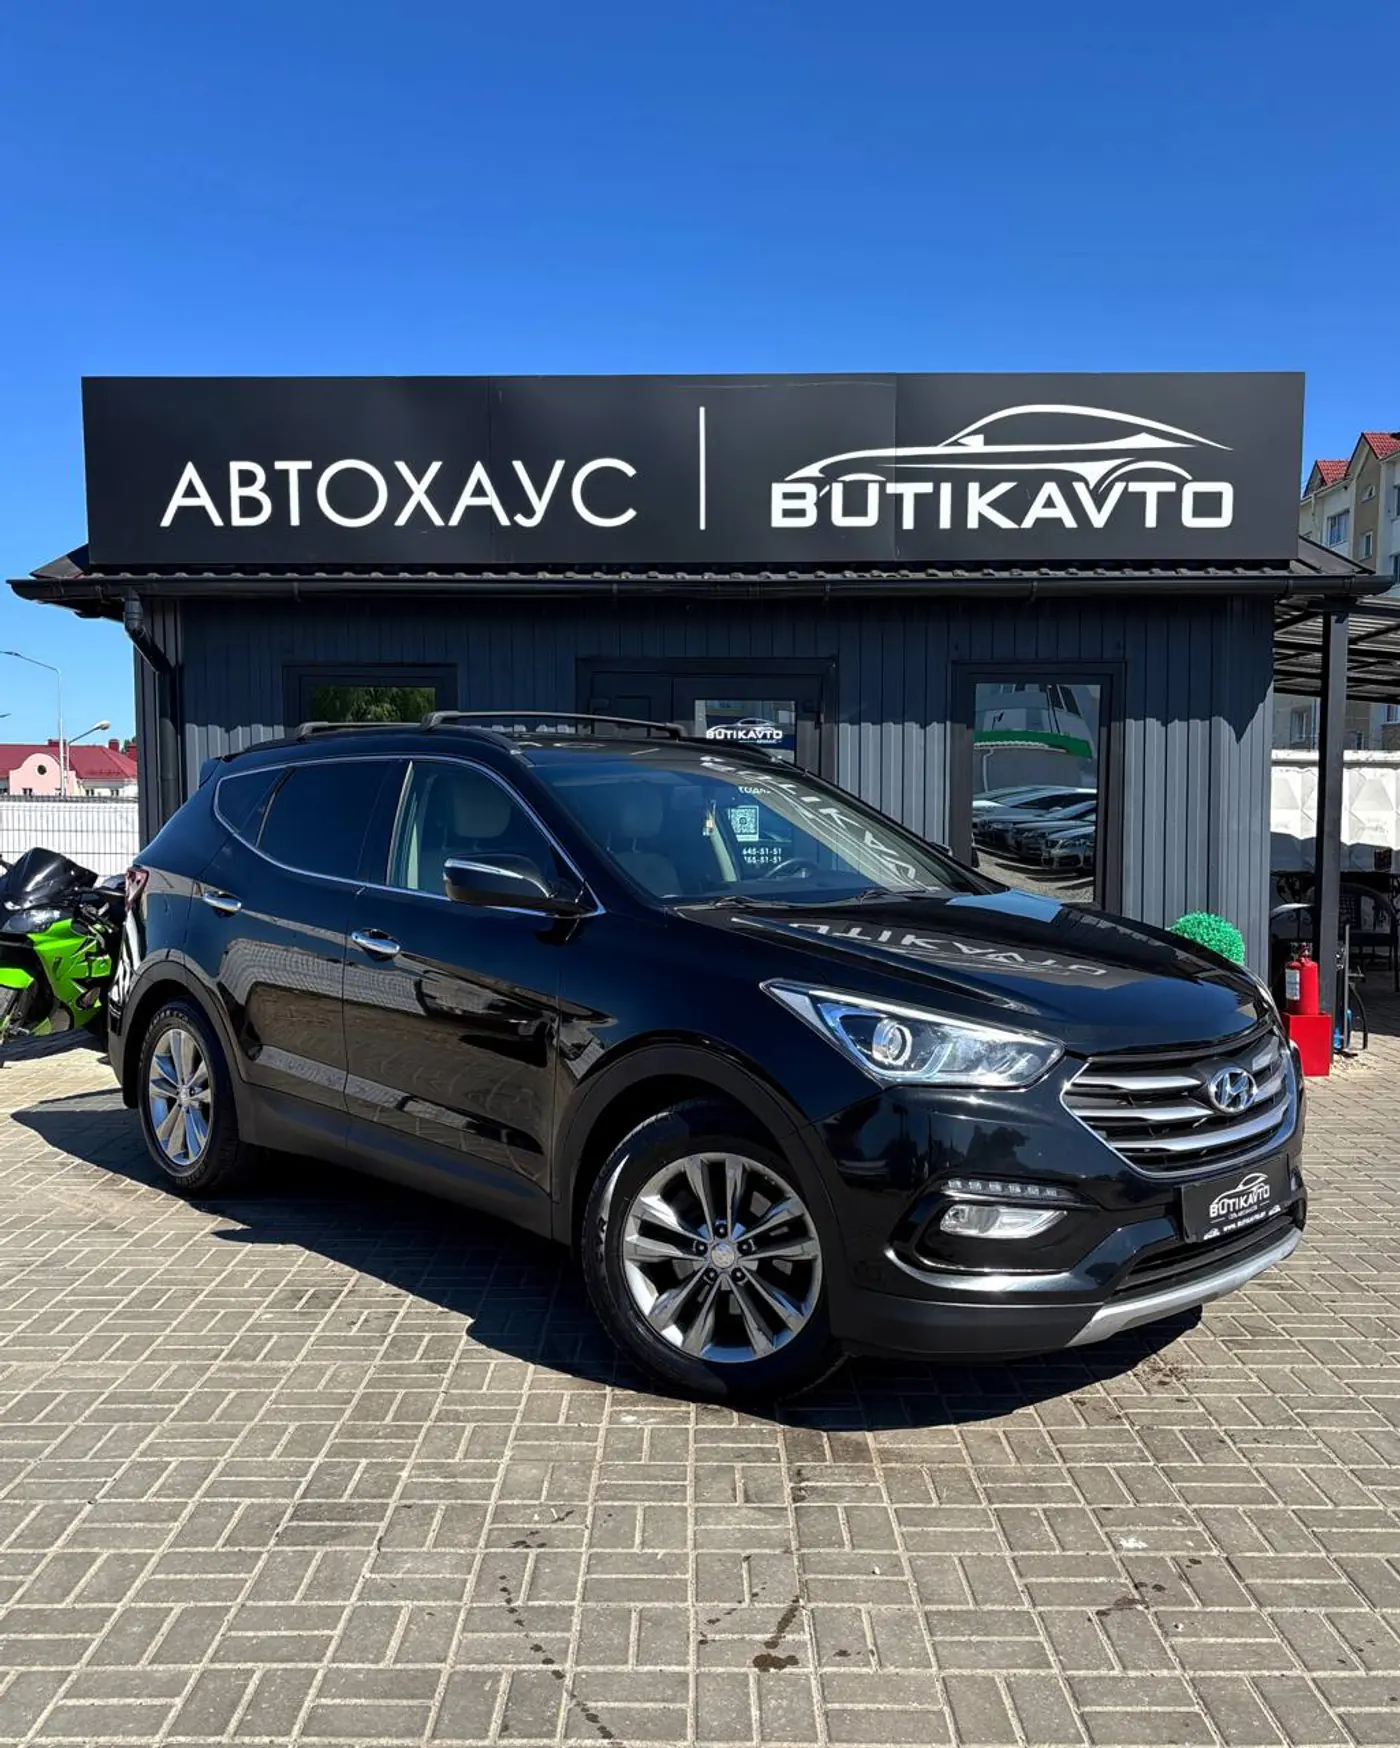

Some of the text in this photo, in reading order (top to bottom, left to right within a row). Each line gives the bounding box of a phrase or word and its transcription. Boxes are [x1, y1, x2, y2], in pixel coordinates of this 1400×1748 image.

[160, 457, 638, 528] АВТОХАУС
[771, 480, 1234, 530] BUTIKAVTO
[706, 730, 782, 739] BUTIKAVTO
[1210, 1185, 1270, 1217] BUTIKAVTO
